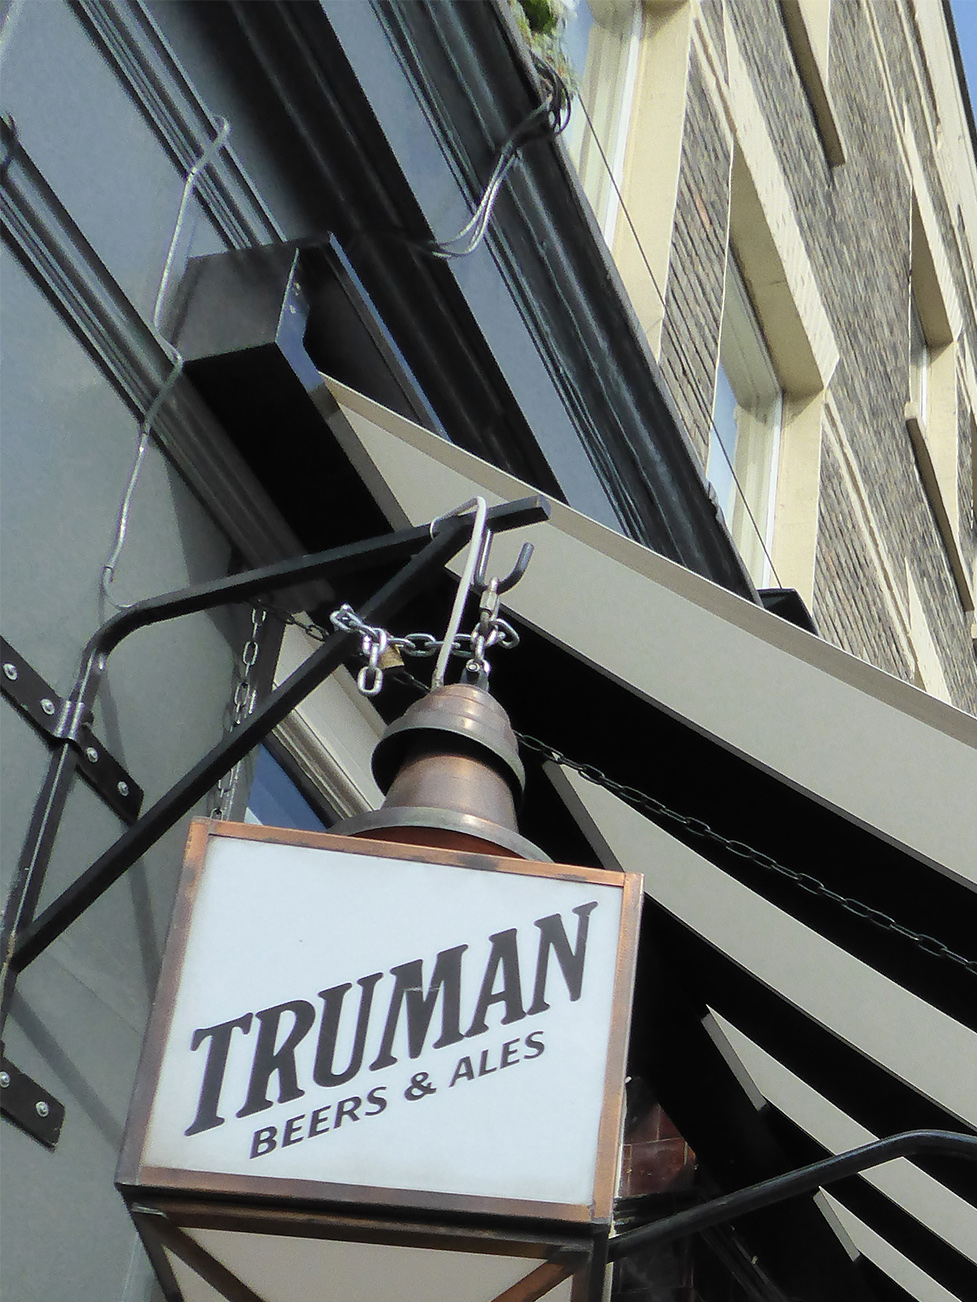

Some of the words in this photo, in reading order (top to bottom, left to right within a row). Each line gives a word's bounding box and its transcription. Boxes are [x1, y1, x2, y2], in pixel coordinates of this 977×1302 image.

[184, 901, 599, 1137] TRUMAN
[249, 1086, 388, 1160] BEERS
[404, 1071, 438, 1102] &
[448, 1030, 546, 1089] ALES
